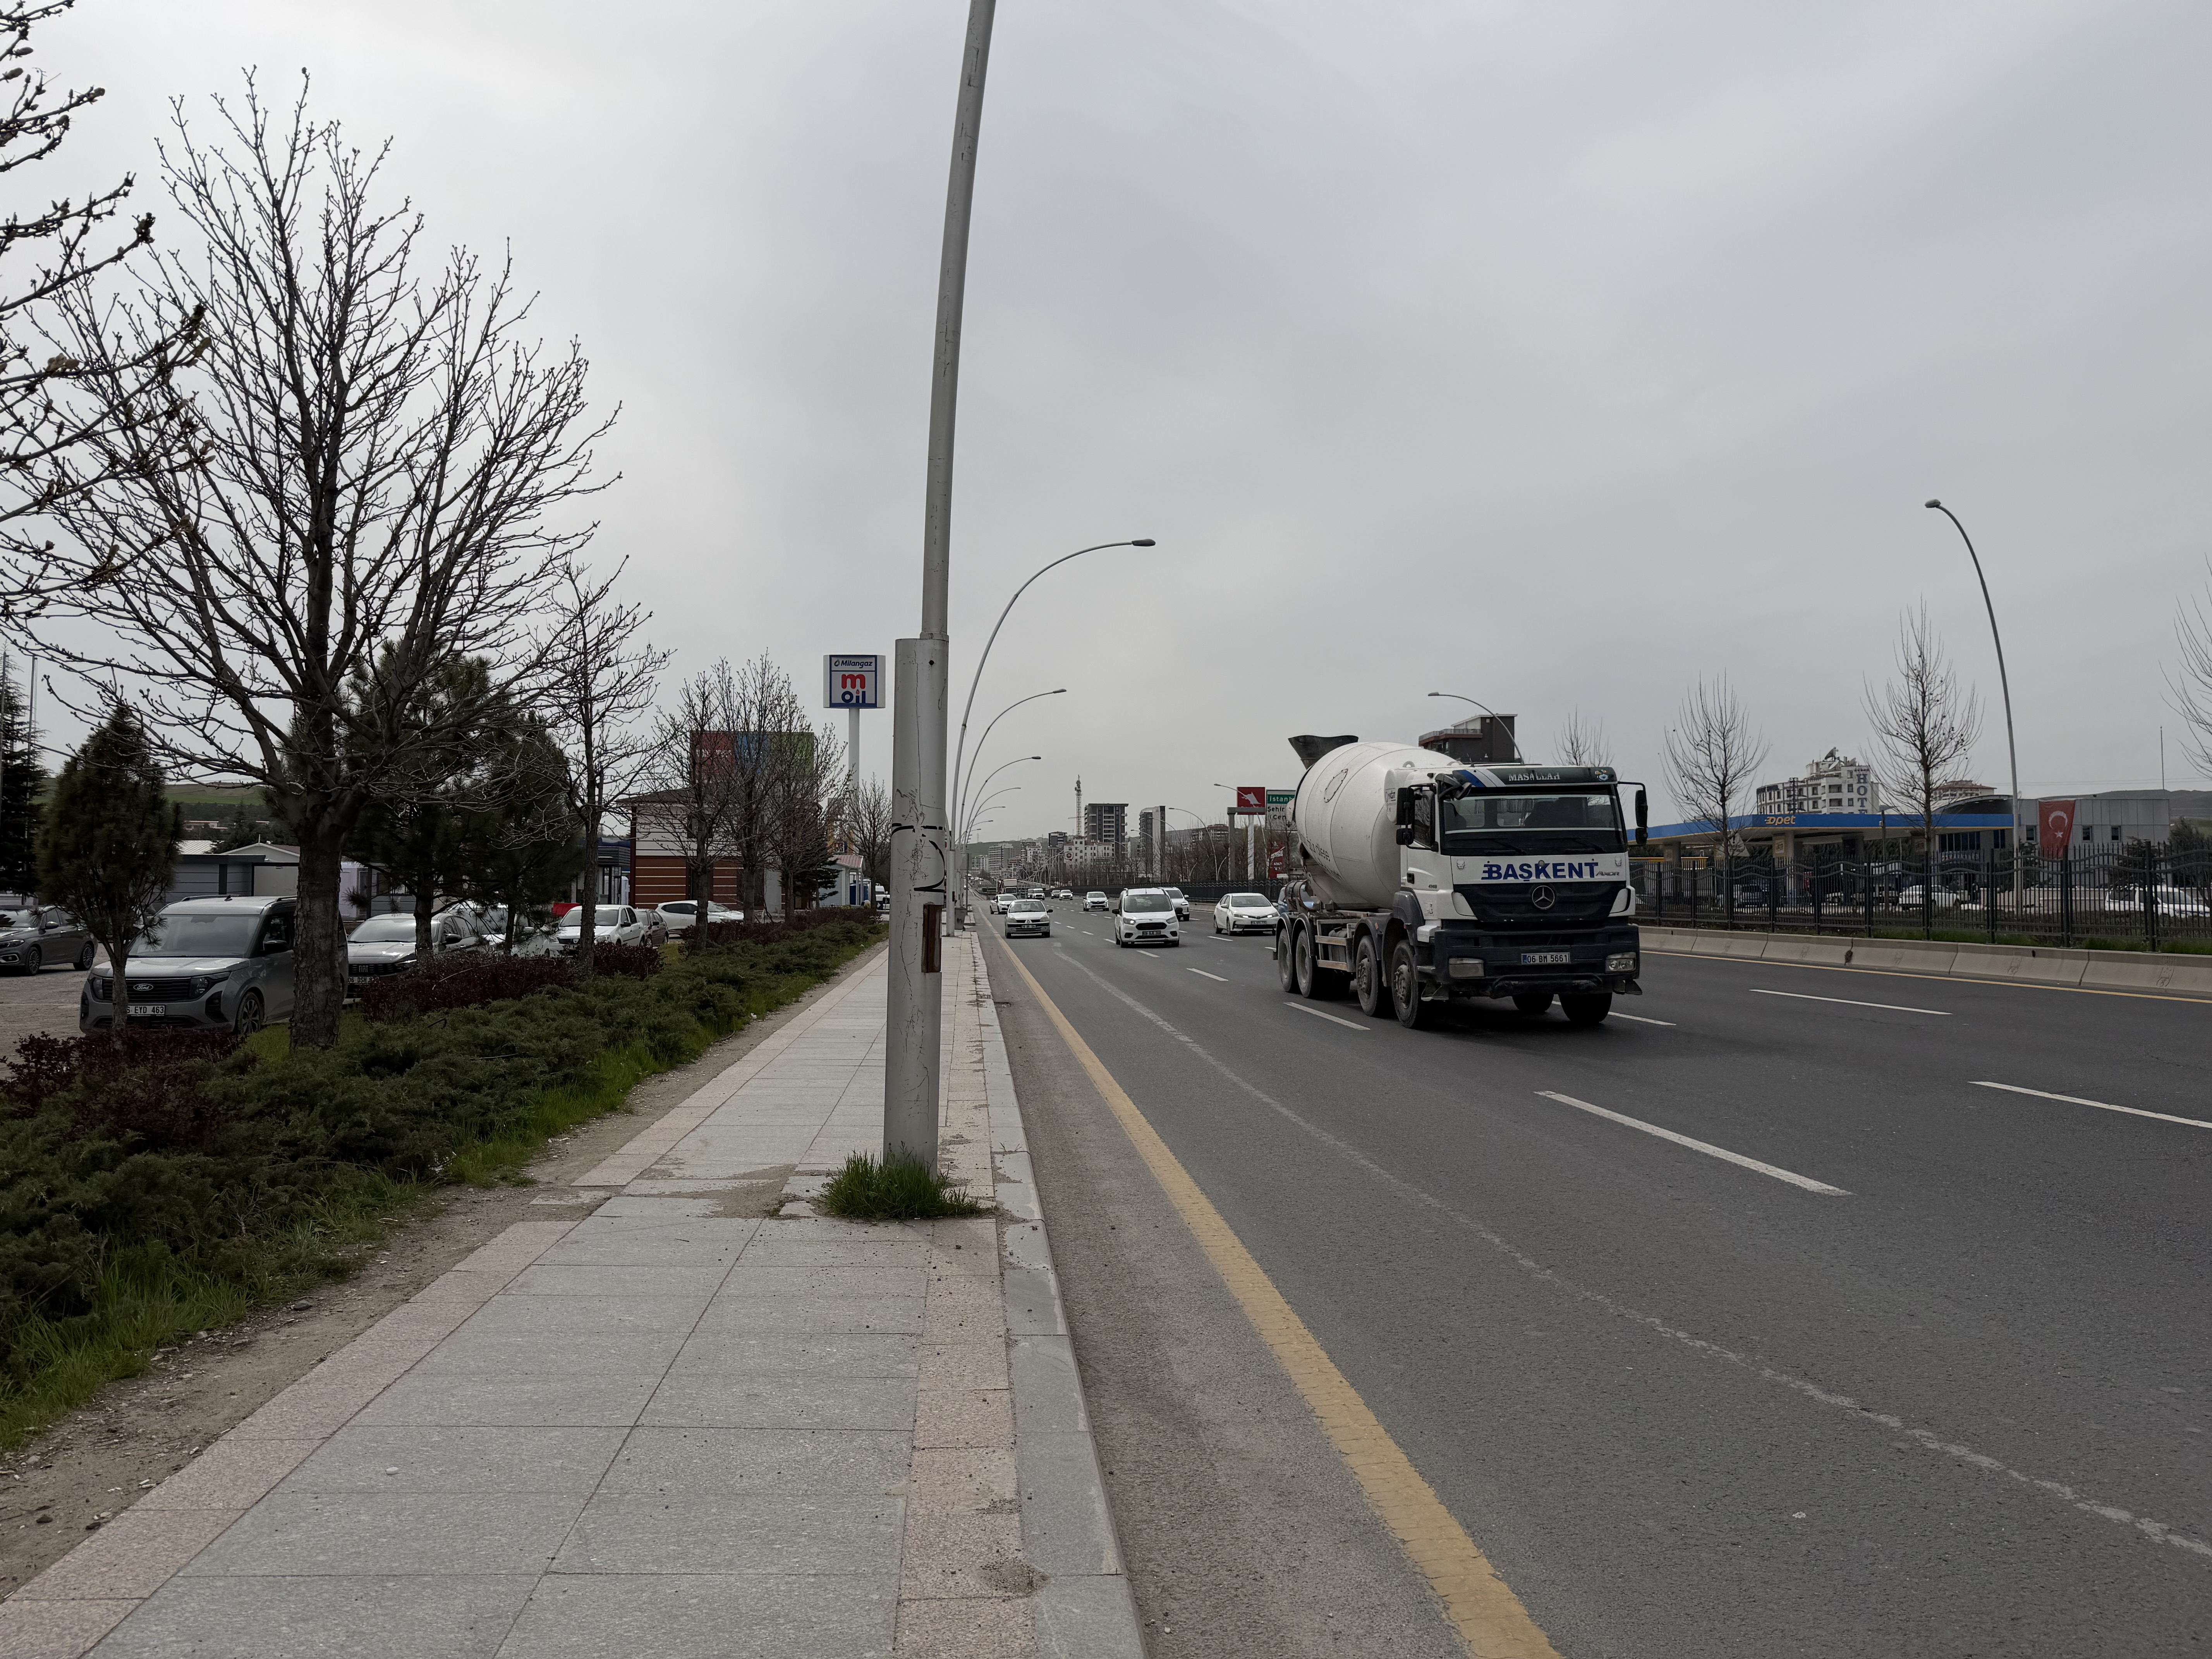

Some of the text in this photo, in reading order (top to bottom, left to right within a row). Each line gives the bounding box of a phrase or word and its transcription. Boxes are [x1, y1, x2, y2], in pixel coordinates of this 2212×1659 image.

[841, 660, 872, 668] Milangaz
[841, 674, 866, 689] m
[1765, 816, 1796, 825] opet
